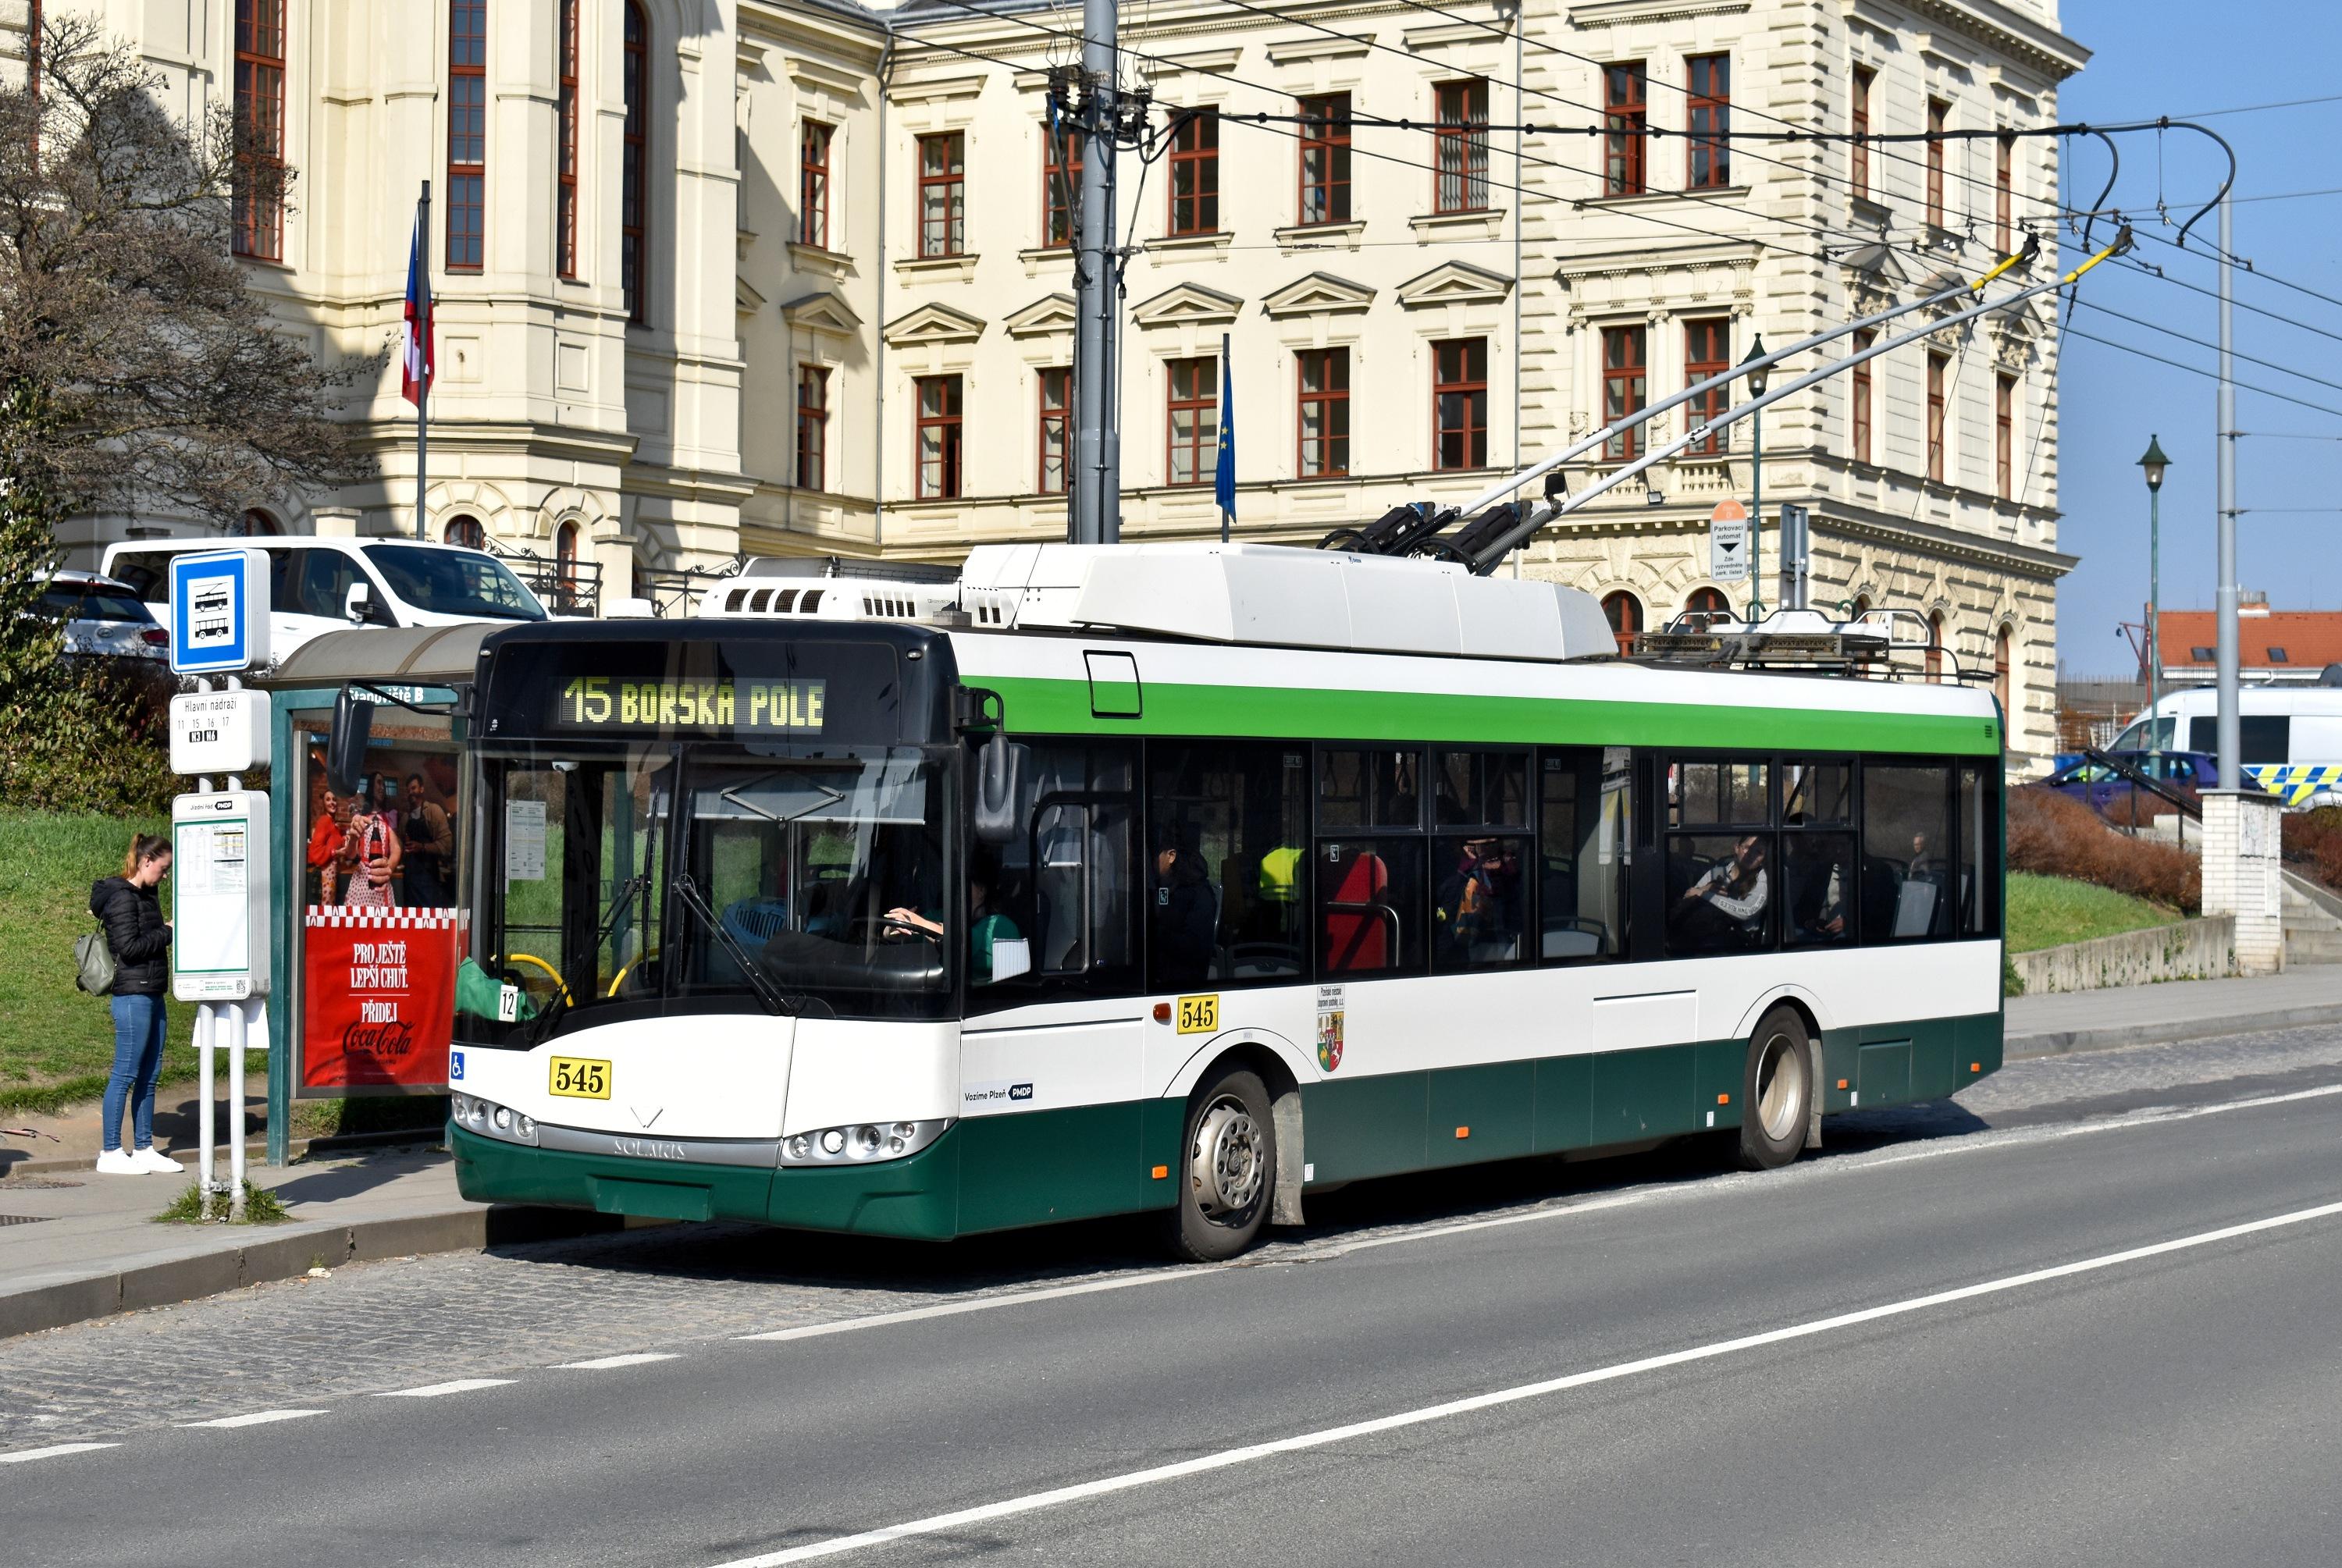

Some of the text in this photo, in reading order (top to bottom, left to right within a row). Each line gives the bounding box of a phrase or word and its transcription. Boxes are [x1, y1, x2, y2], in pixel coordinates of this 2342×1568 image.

[184, 697, 237, 712] Hlavní nádraží
[414, 687, 424, 702] B
[564, 677, 824, 727] 15 BORSKÁ POLE
[178, 716, 230, 730] 11 15 16 17
[191, 730, 215, 742] N3 N6
[353, 940, 407, 964] PRO JEŠTĚ
[351, 965, 379, 988] LEPŠÍ
[361, 998, 398, 1023] PŘIDEJ
[503, 992, 514, 1015] 12
[1182, 1001, 1214, 1029] 545
[556, 1062, 603, 1093] 545
[965, 1086, 1031, 1101] Vozíme Plzeň PMDP
[614, 1138, 688, 1161] SOLARIS
